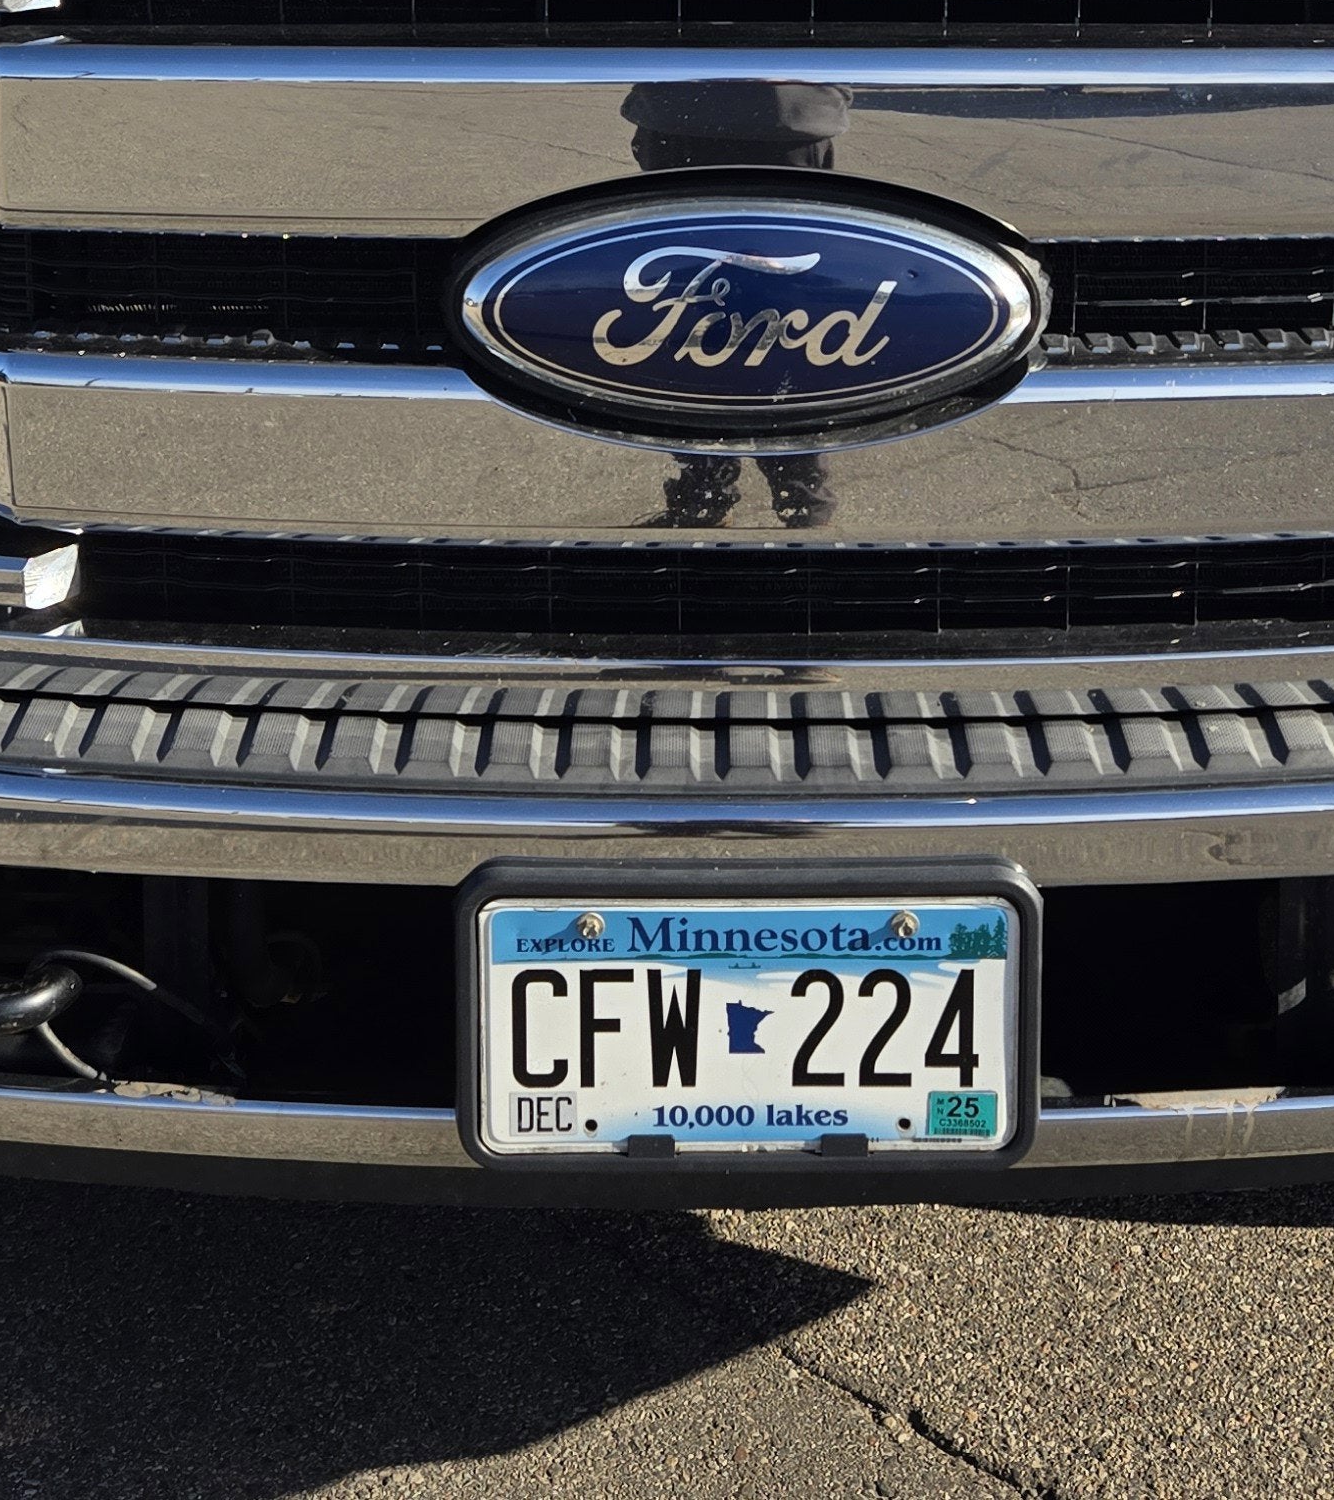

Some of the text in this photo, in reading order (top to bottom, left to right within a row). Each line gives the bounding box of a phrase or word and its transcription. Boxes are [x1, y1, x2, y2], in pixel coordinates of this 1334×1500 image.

[592, 244, 898, 367] Ford
[516, 938, 616, 953] EXPLORE
[511, 968, 980, 1088] CFW 224
[517, 1096, 573, 1133] DEC
[652, 1104, 849, 1130] 10,000 lakes
[947, 1096, 979, 1118] 25
